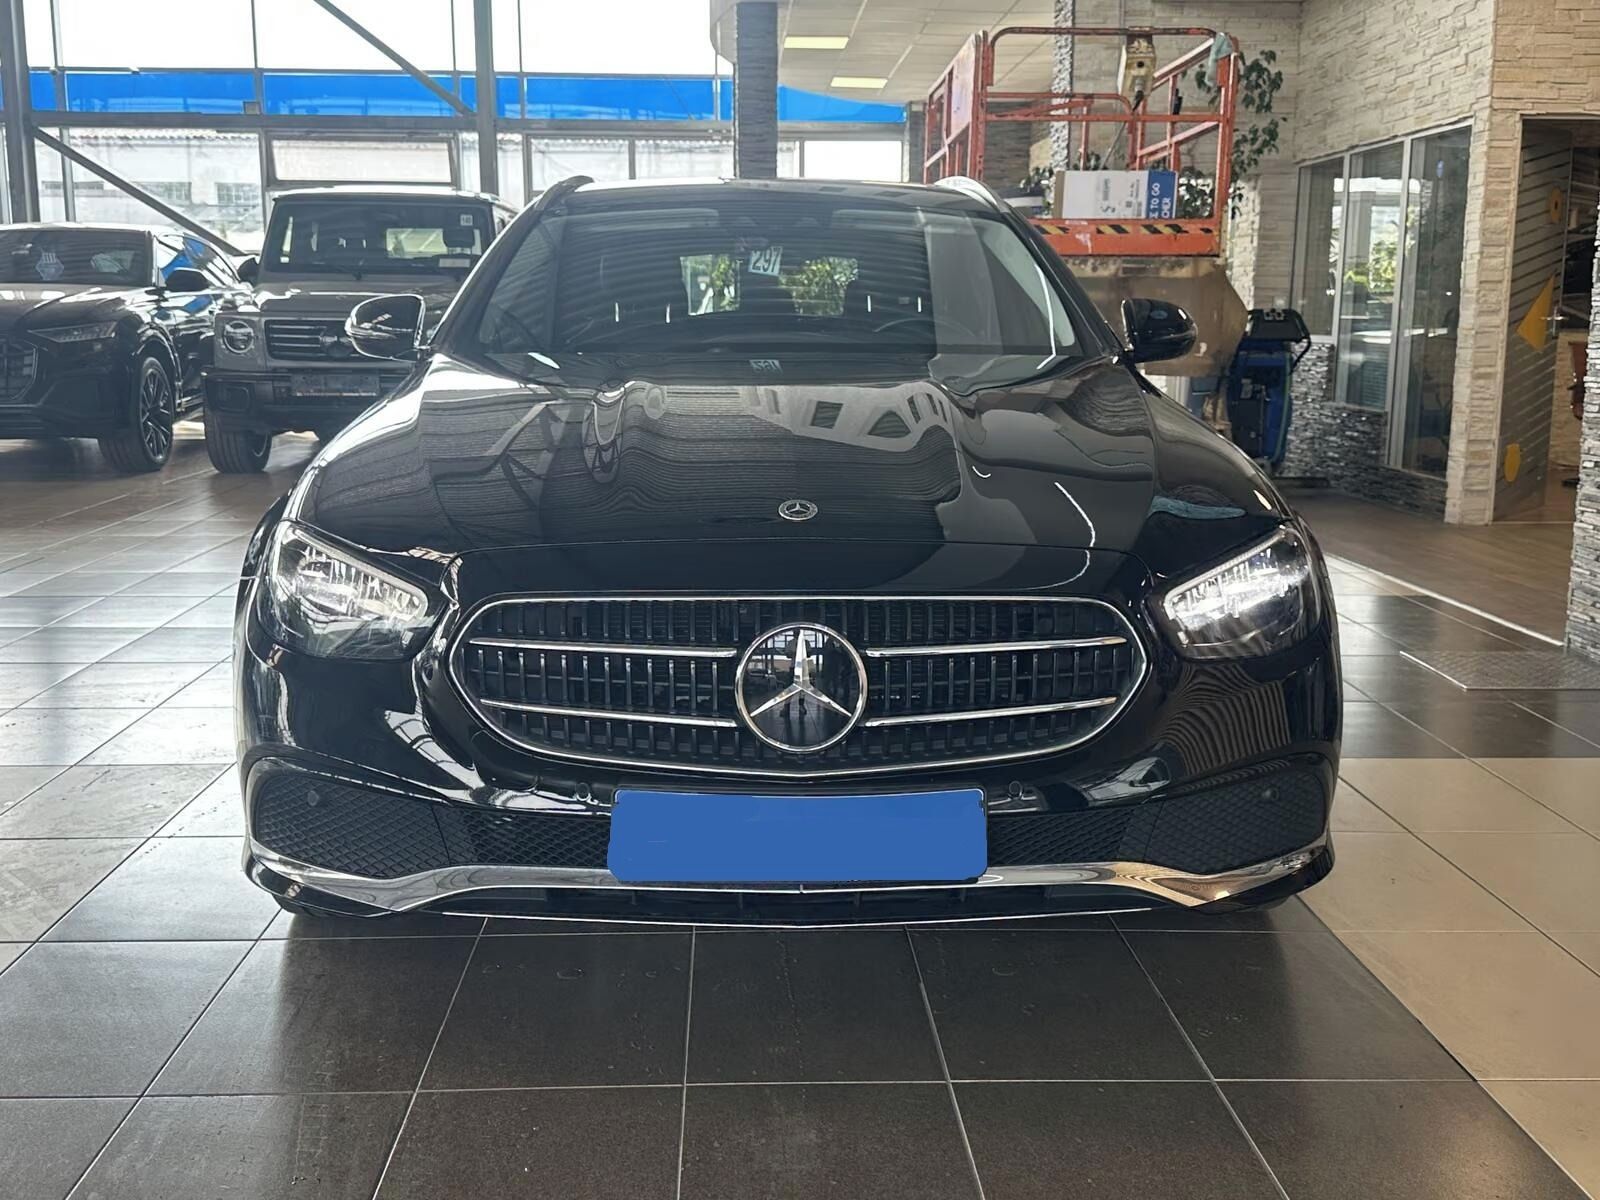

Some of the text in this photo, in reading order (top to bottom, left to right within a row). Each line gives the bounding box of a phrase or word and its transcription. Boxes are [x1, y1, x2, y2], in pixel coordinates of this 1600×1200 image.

[1151, 182, 1160, 196] GO
[1150, 198, 1160, 209] TO
[752, 247, 781, 272] 297
